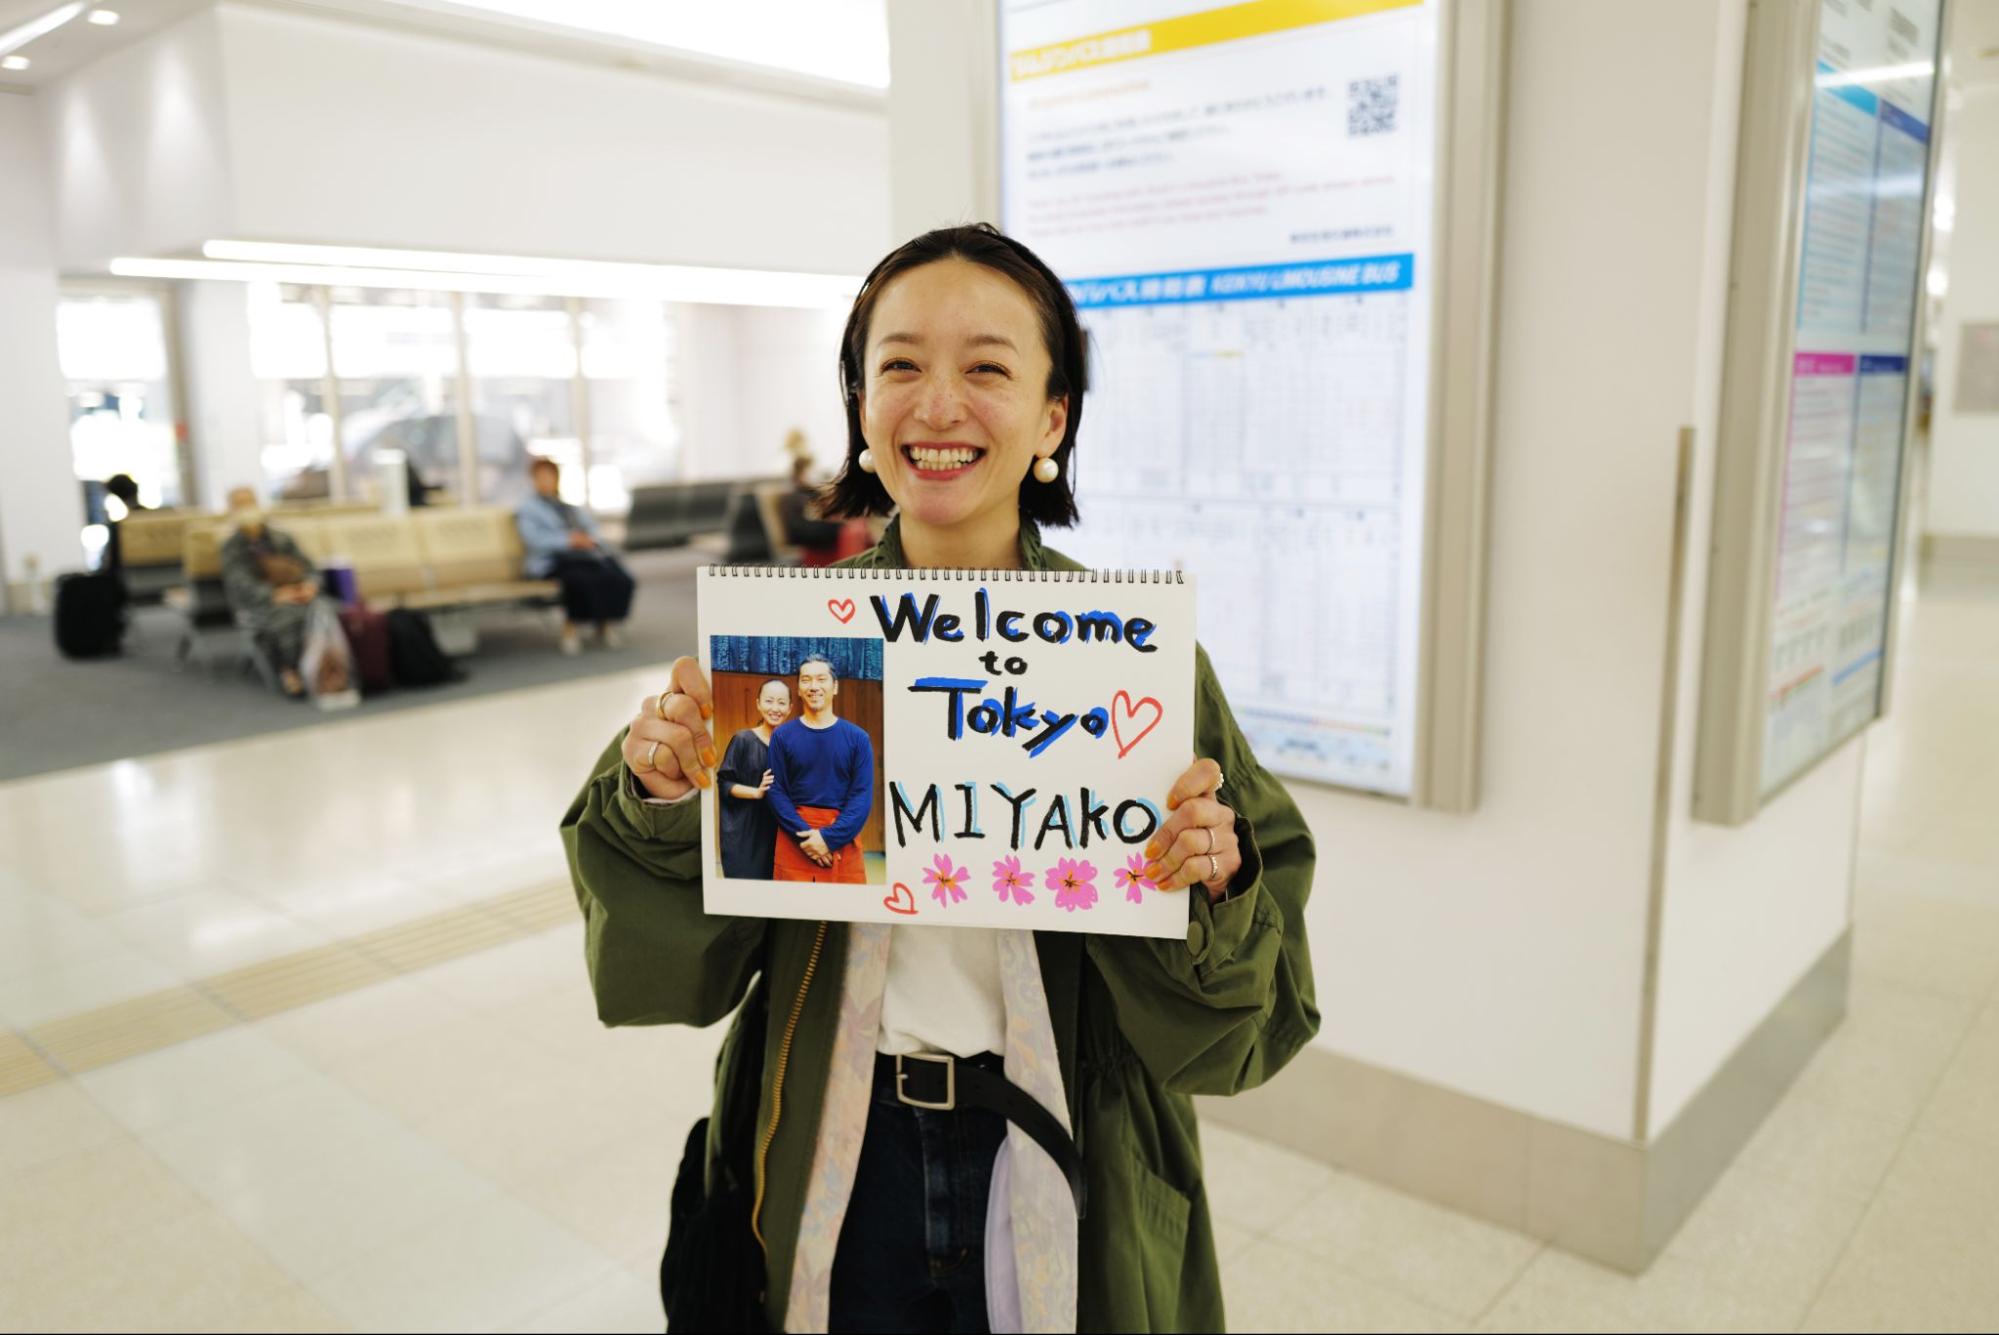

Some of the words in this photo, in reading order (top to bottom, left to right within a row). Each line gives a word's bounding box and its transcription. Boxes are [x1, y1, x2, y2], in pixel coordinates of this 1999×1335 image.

[1361, 261, 1400, 285] BUS
[869, 587, 1159, 653] Welcome
[978, 650, 1029, 677] to
[908, 676, 1110, 759] Tokyo
[889, 780, 1163, 851] MIYAKO
